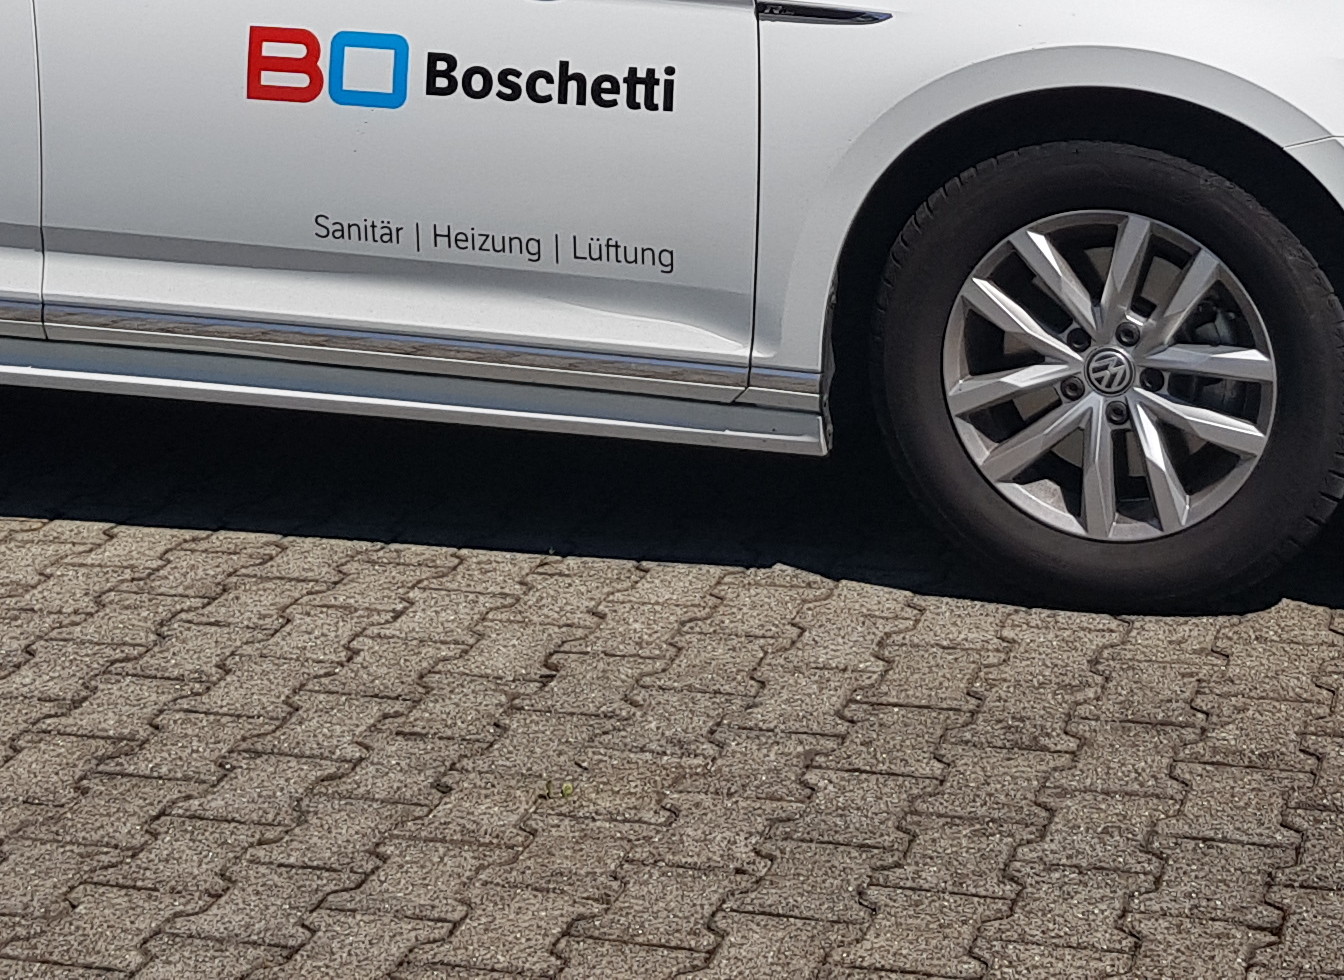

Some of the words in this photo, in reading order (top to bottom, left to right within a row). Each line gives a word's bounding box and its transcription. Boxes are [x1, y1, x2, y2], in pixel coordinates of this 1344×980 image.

[246, 25, 410, 110] BO
[425, 51, 676, 112] Boschetti
[313, 213, 405, 245] Sanitär
[432, 222, 542, 263] Heizung
[571, 235, 675, 274] Lüftung
